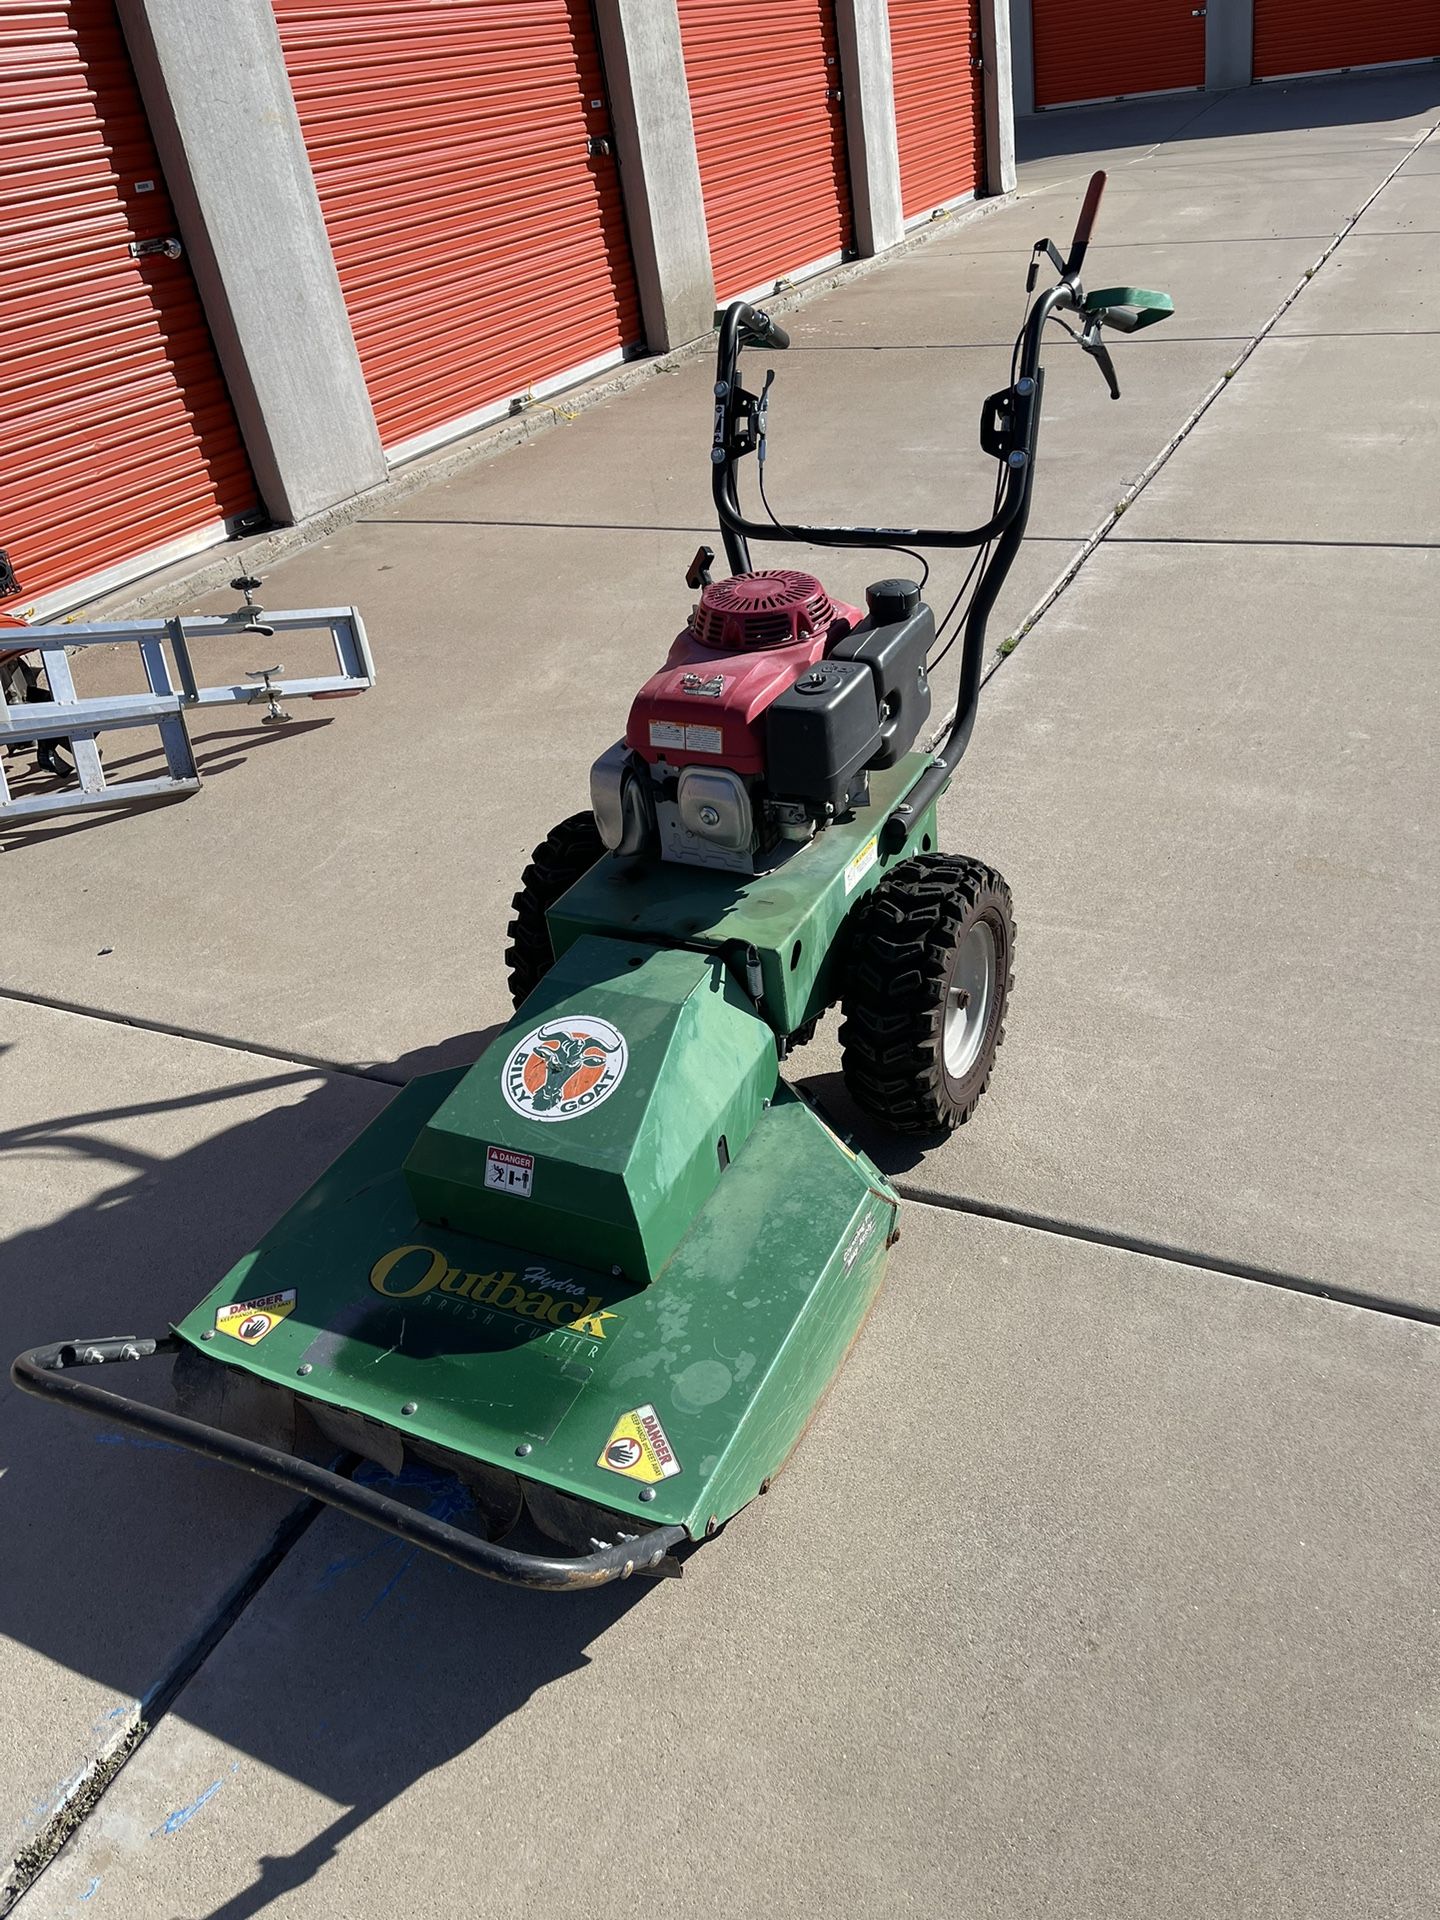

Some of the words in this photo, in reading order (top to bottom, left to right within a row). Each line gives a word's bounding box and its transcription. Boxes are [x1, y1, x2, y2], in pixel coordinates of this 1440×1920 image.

[511, 1052, 532, 1107] BILLY
[560, 1070, 615, 1113] GOAT
[500, 1152, 532, 1168] DANGER
[369, 1245, 618, 1339] Outback
[522, 1266, 588, 1296] Hydro
[230, 1294, 283, 1315] DANGER
[422, 1295, 497, 1325] BRUSH
[631, 1414, 640, 1425] KEEP
[636, 1426, 647, 1442] HANDS
[646, 1450, 656, 1462] FEET
[642, 1415, 672, 1466] DANGER
